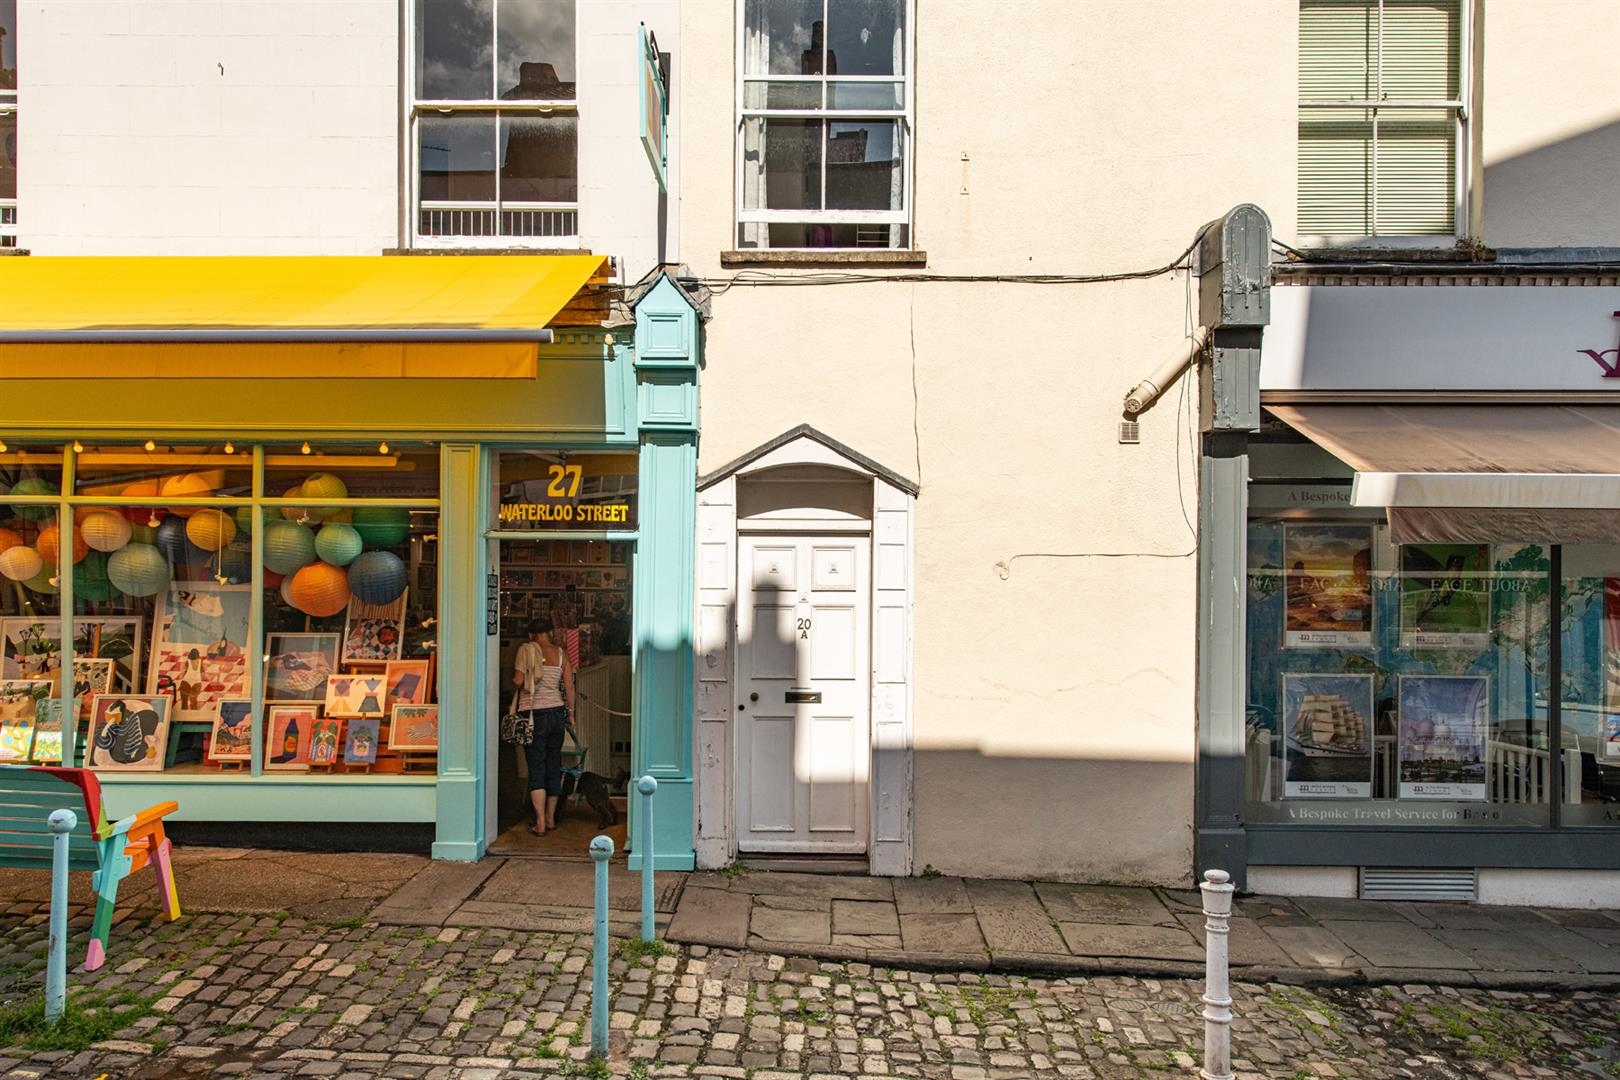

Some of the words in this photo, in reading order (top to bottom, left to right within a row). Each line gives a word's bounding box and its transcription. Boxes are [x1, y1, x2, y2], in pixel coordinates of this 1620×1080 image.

[548, 465, 583, 497] 27
[1301, 491, 1352, 504] Bespoke
[500, 503, 573, 521] WATERLOO
[577, 504, 629, 522] STREET
[797, 618, 811, 630] 20
[800, 630, 808, 639] A
[1299, 807, 1349, 820] Bespoke
[1353, 807, 1391, 819] Travel
[1395, 807, 1438, 819] Service
[1442, 807, 1461, 819] for
